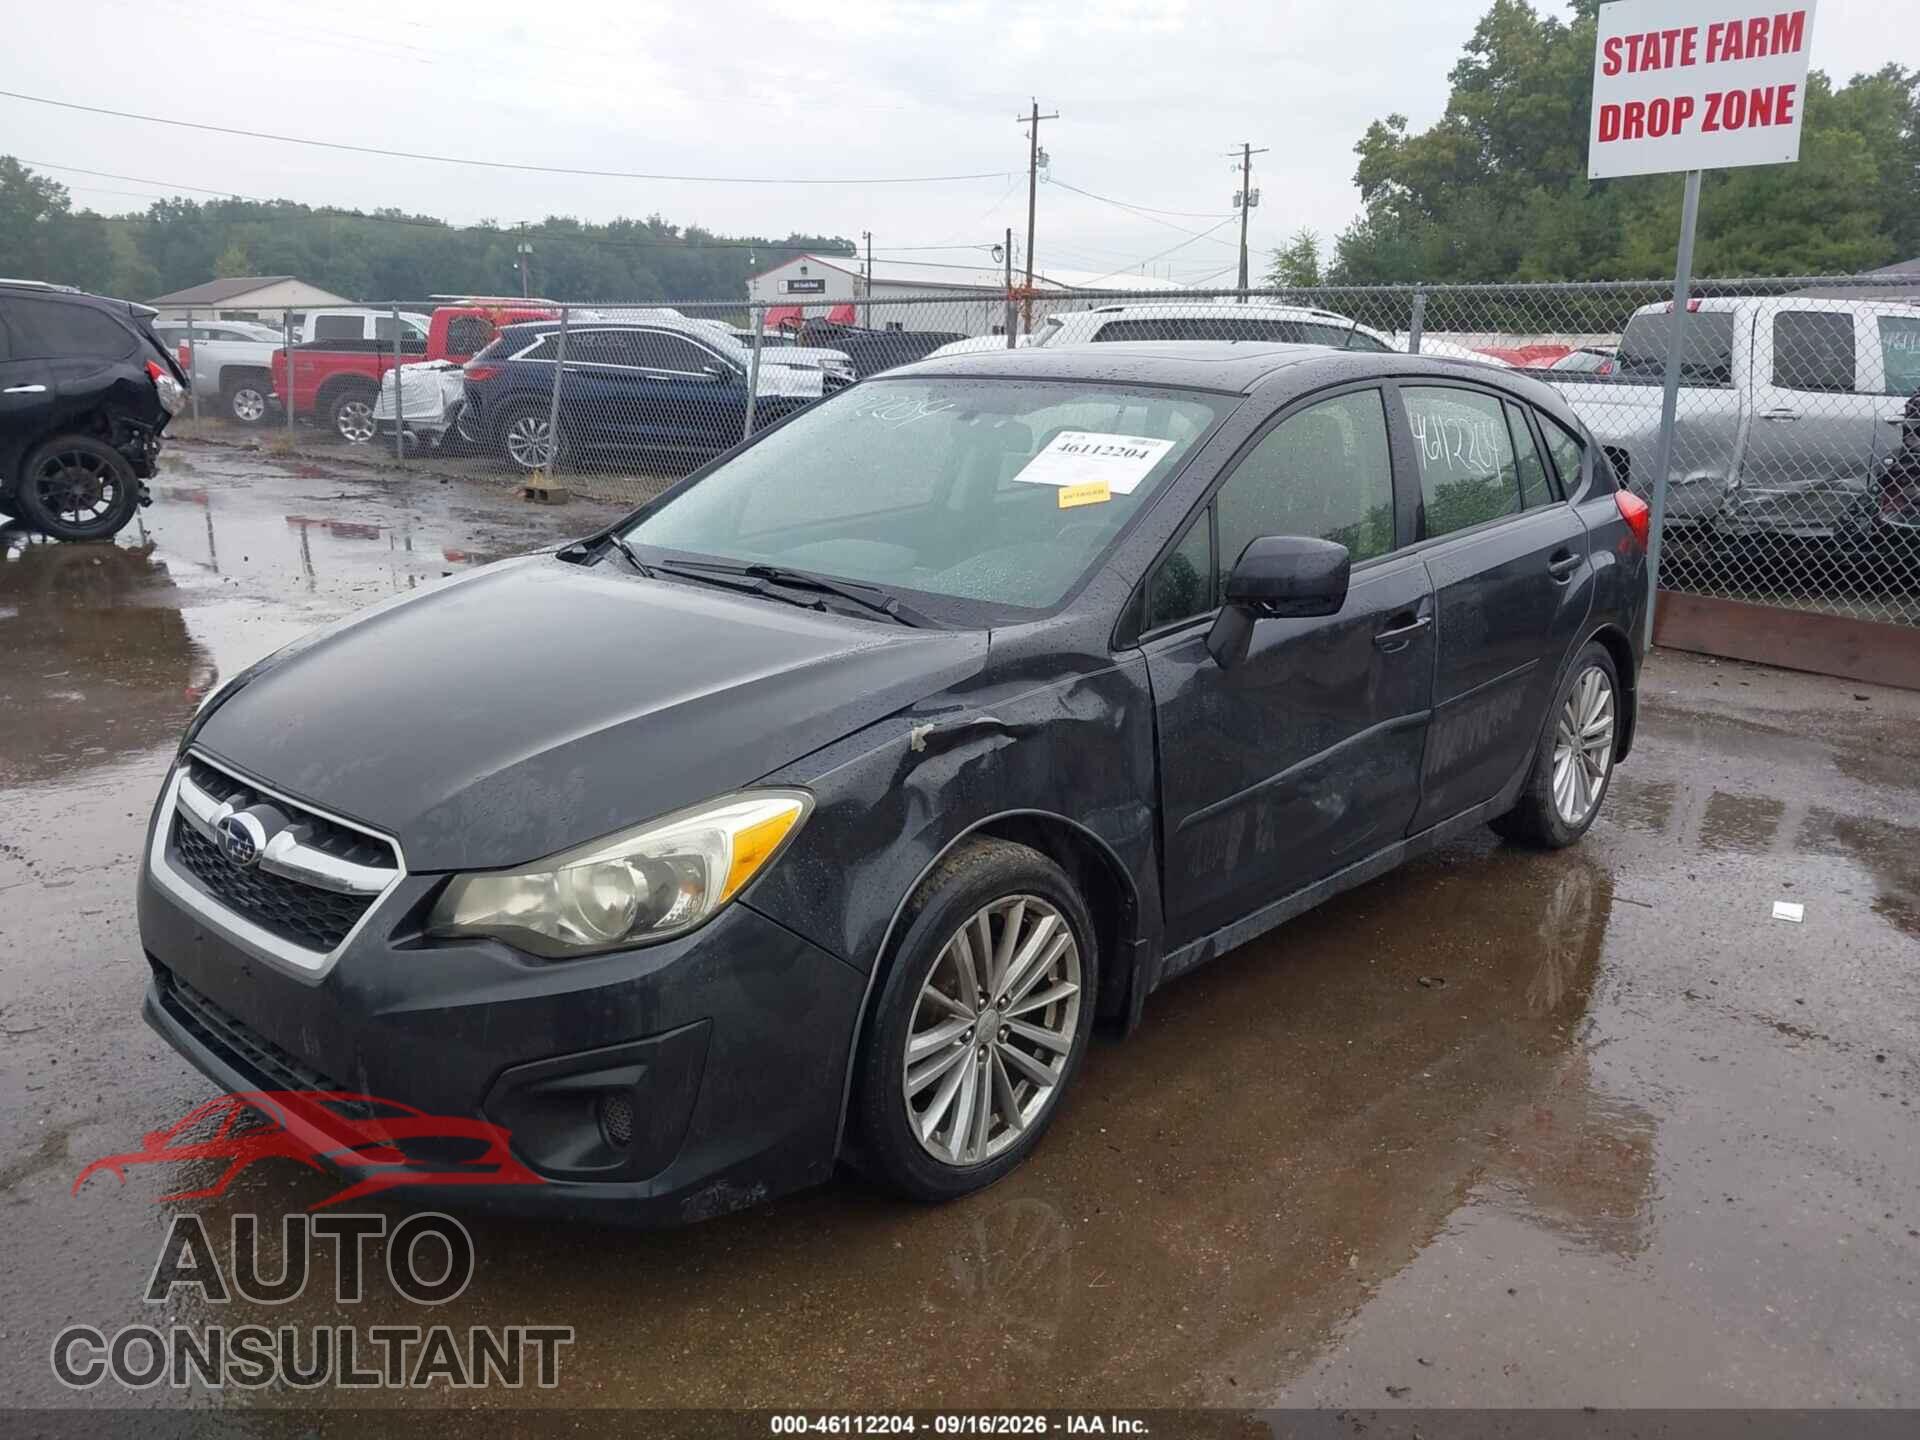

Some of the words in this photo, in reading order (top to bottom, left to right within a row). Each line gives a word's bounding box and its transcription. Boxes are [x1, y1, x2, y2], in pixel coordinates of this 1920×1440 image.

[1602, 26, 1698, 77] STATE
[1705, 10, 1806, 64] FARM
[1598, 95, 1694, 143] DROP
[1701, 83, 1797, 133] ZONE
[1057, 442, 1150, 460] 46112204
